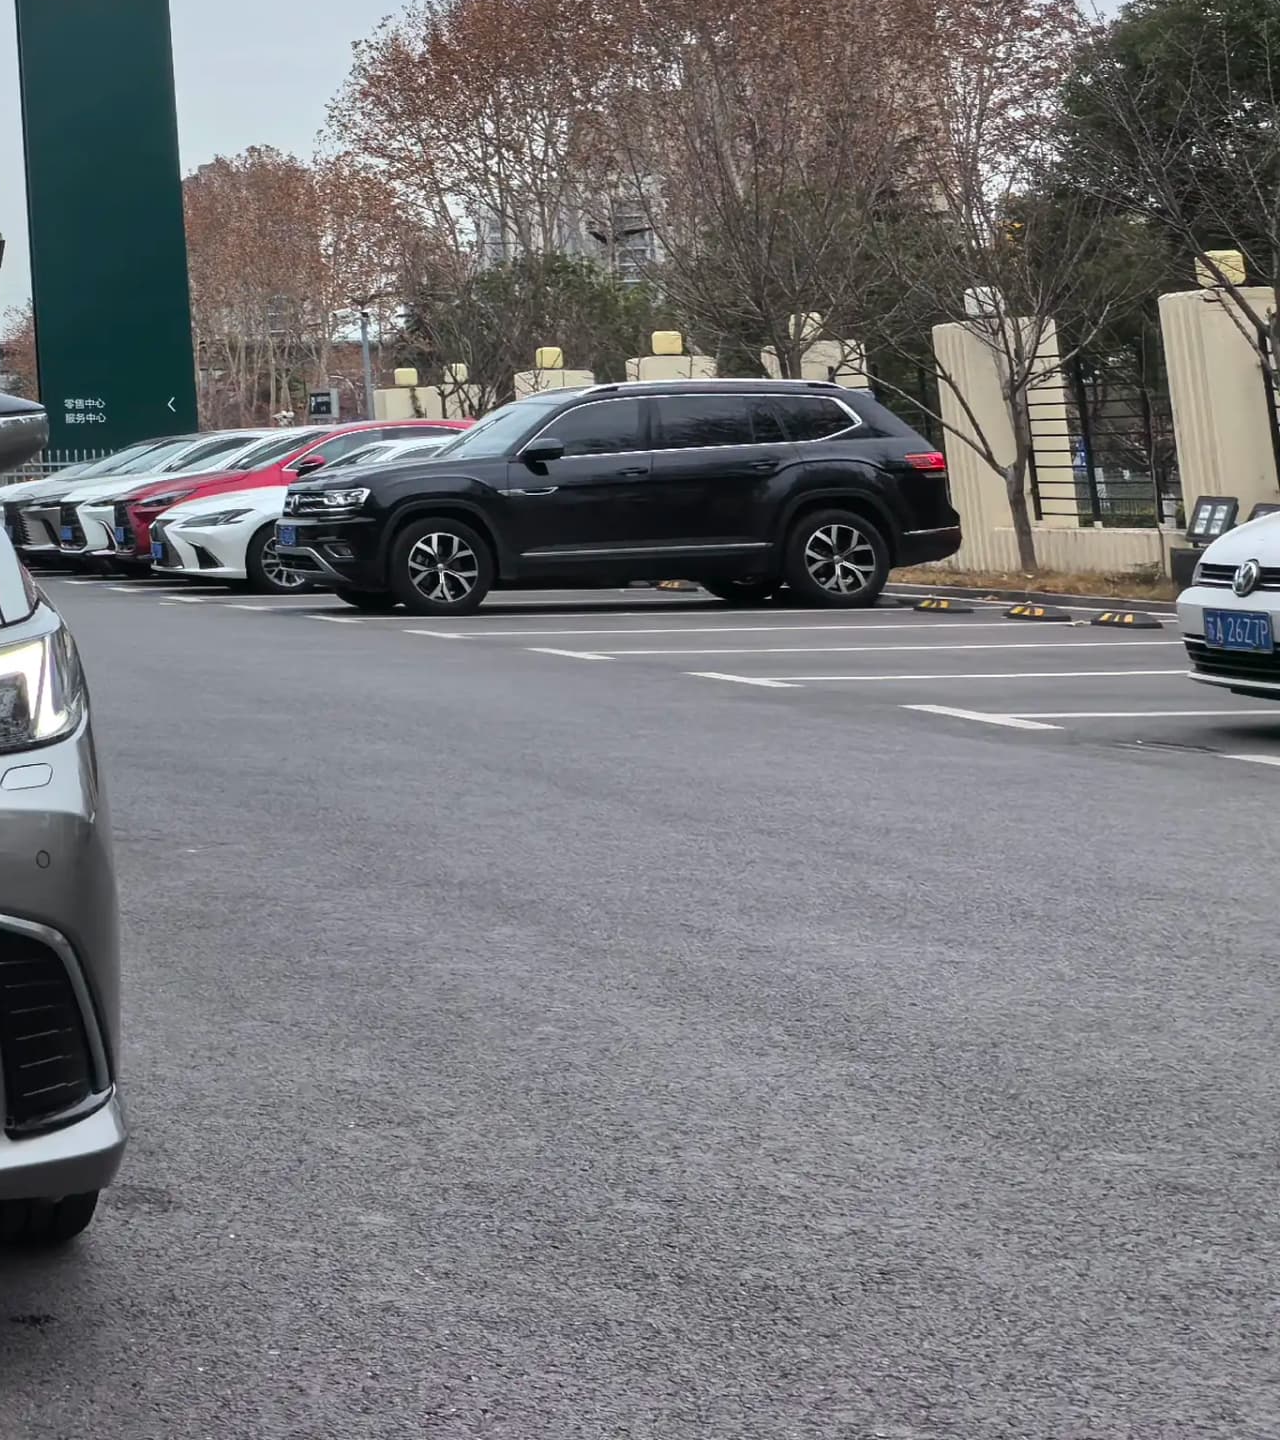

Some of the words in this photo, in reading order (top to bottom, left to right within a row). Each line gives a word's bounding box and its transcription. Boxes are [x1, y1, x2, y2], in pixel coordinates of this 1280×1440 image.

[63, 397, 106, 409] 零售中心
[65, 412, 107, 424] 服务中心
